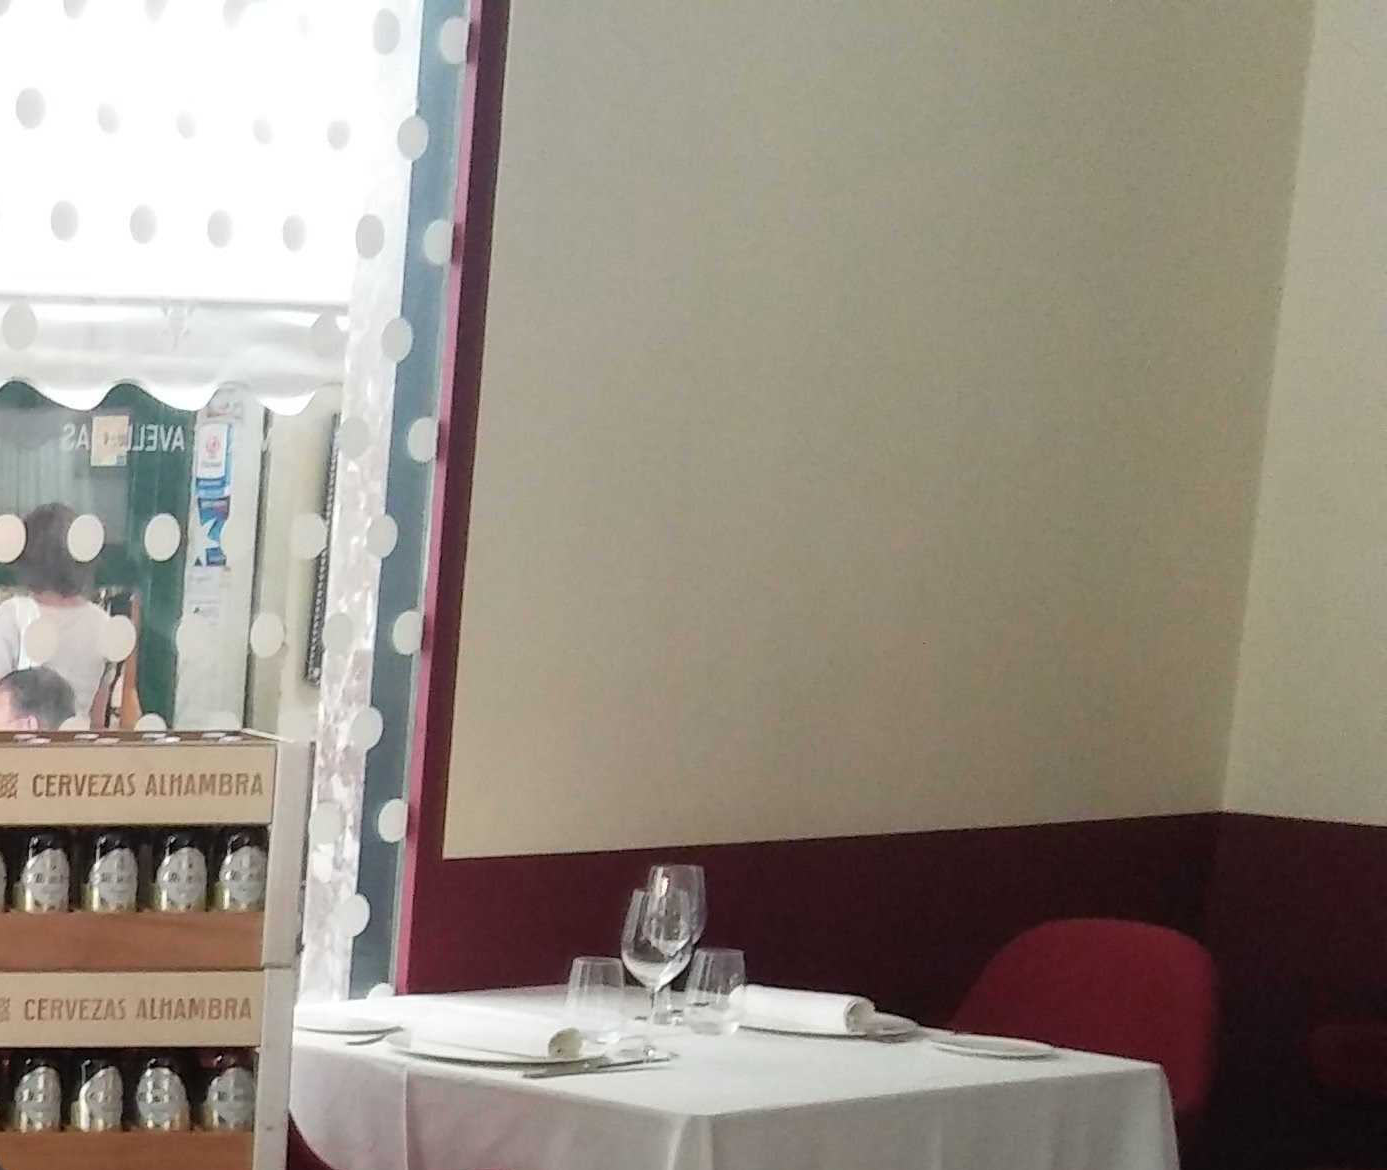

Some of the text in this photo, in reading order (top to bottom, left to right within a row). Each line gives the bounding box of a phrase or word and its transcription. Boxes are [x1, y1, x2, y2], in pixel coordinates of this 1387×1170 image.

[32, 773, 263, 797] CERVEZAS ALHAMBRA
[24, 997, 251, 1021] CERVEZAS ALHAMBRA
